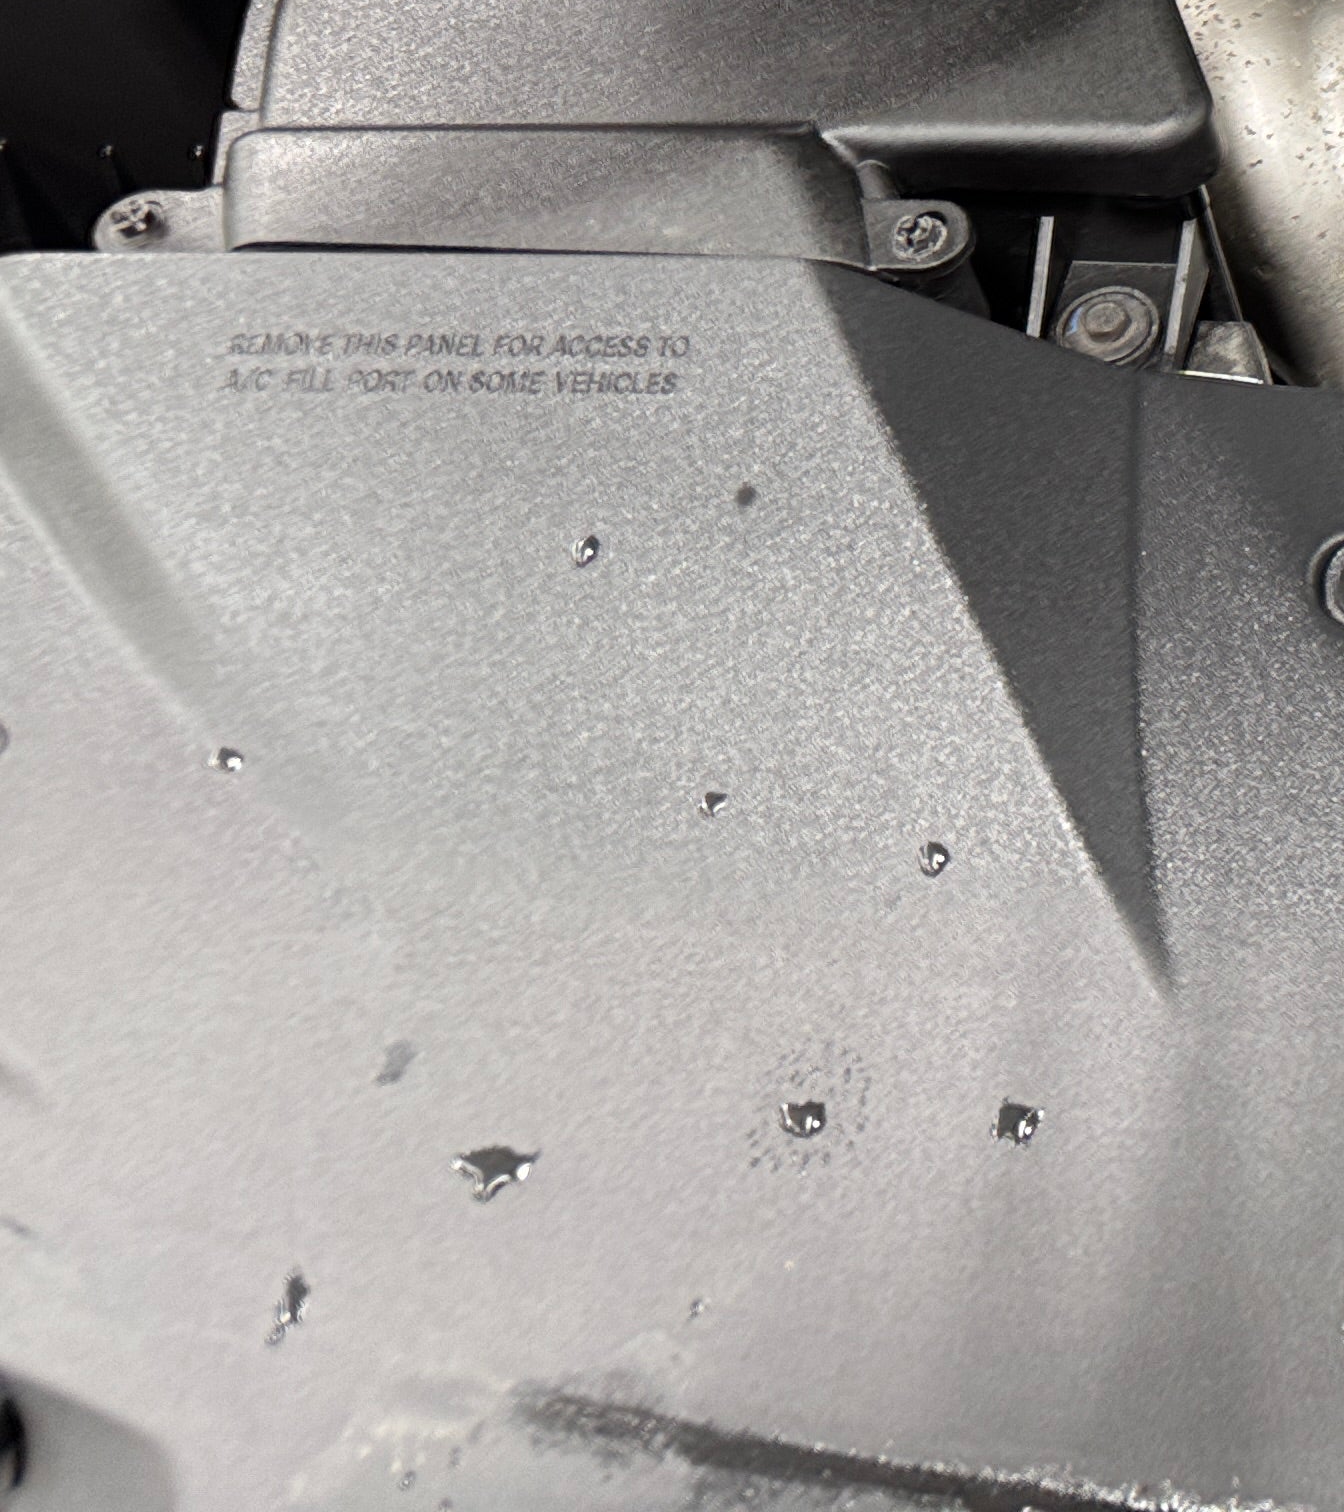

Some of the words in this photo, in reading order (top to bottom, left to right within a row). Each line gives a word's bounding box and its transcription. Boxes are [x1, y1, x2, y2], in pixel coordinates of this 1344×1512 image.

[228, 332, 334, 356] REMOVE
[342, 333, 400, 356] THIS
[403, 333, 484, 357] PANEL
[492, 333, 545, 357] FOR
[550, 334, 651, 358] ACCESS
[655, 334, 690, 357] TO
[217, 367, 274, 392] A/C
[283, 366, 336, 393] FILL
[348, 368, 416, 393] PORT
[422, 369, 462, 393] ON
[467, 369, 547, 394] SOME
[553, 369, 680, 395] VEHICLES
